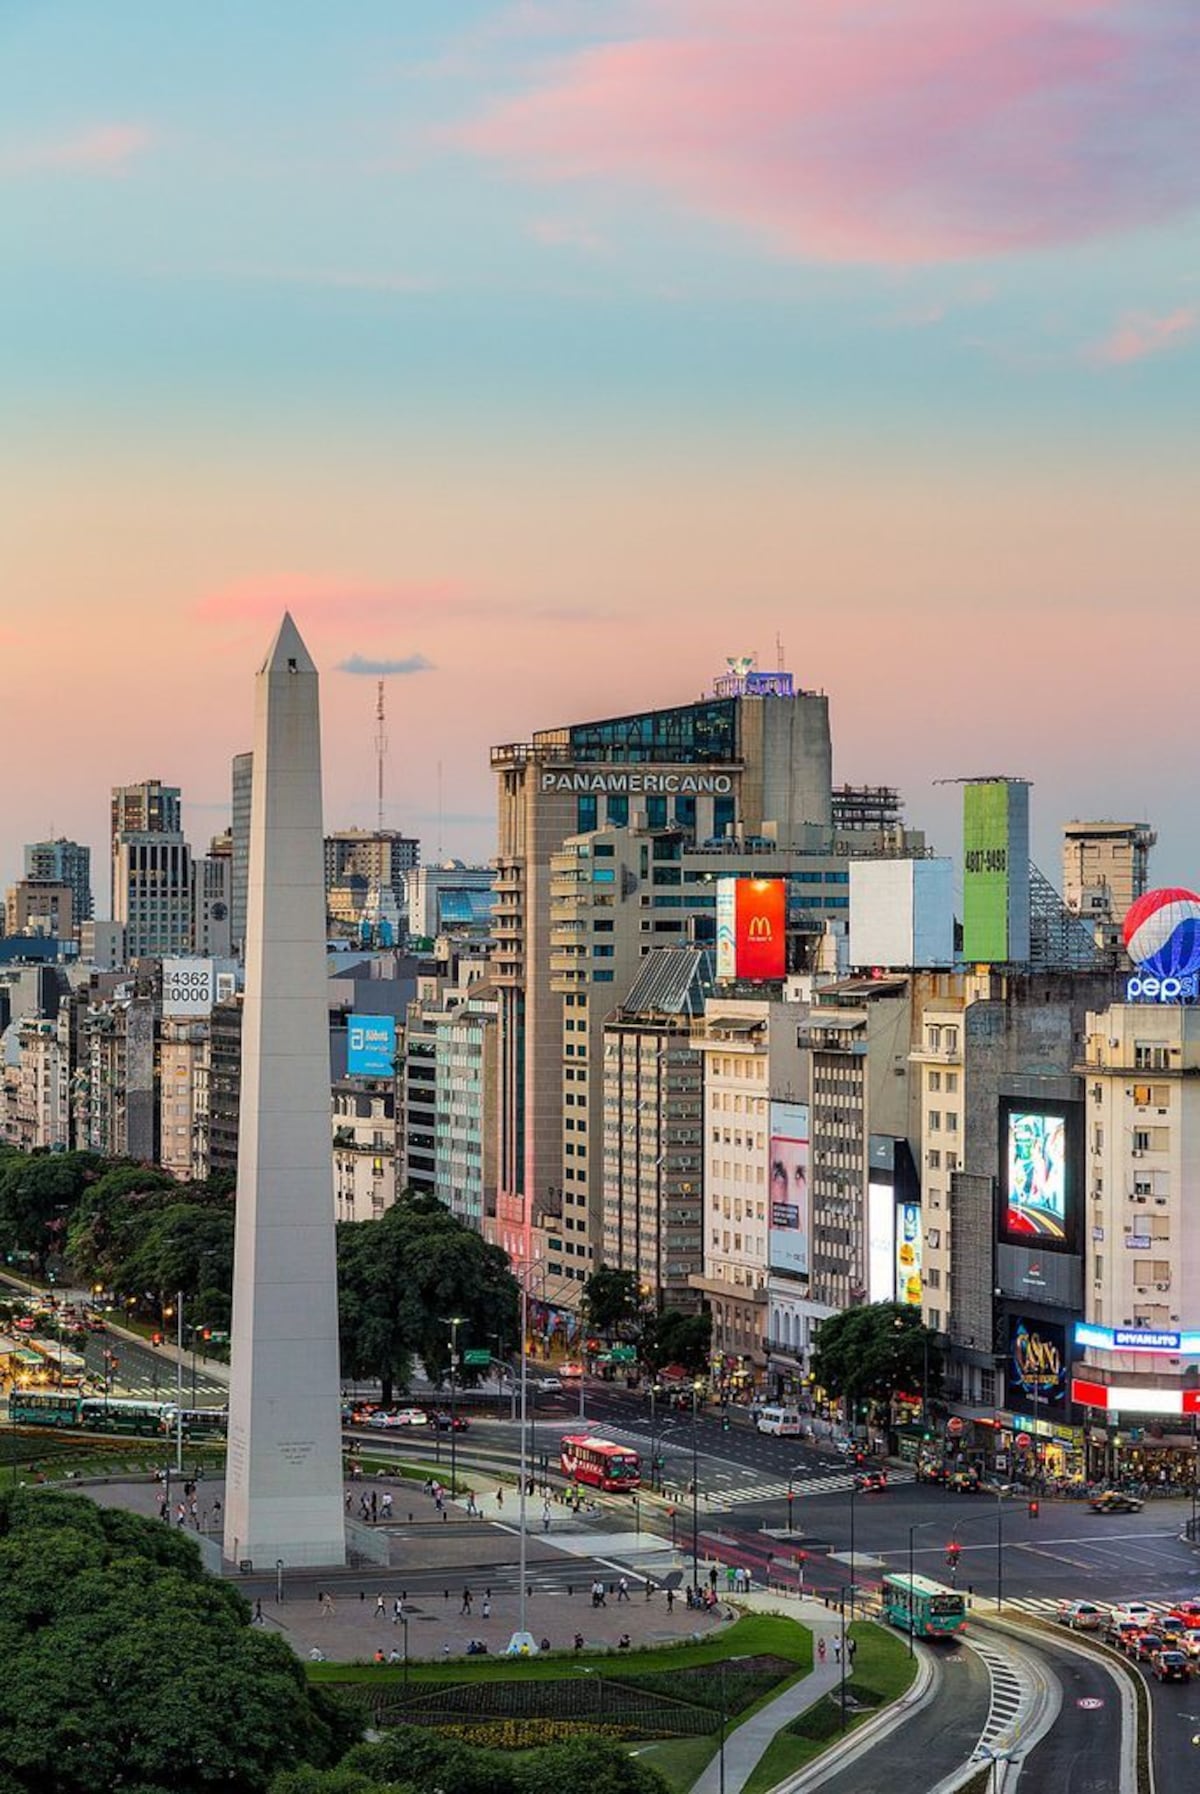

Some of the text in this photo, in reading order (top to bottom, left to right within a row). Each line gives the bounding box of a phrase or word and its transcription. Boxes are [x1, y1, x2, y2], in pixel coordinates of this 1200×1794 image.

[542, 773, 732, 793] PANAMERICANO
[171, 972, 209, 986] 4362
[1127, 973, 1199, 1001] pepsi
[171, 988, 209, 1002] 0000
